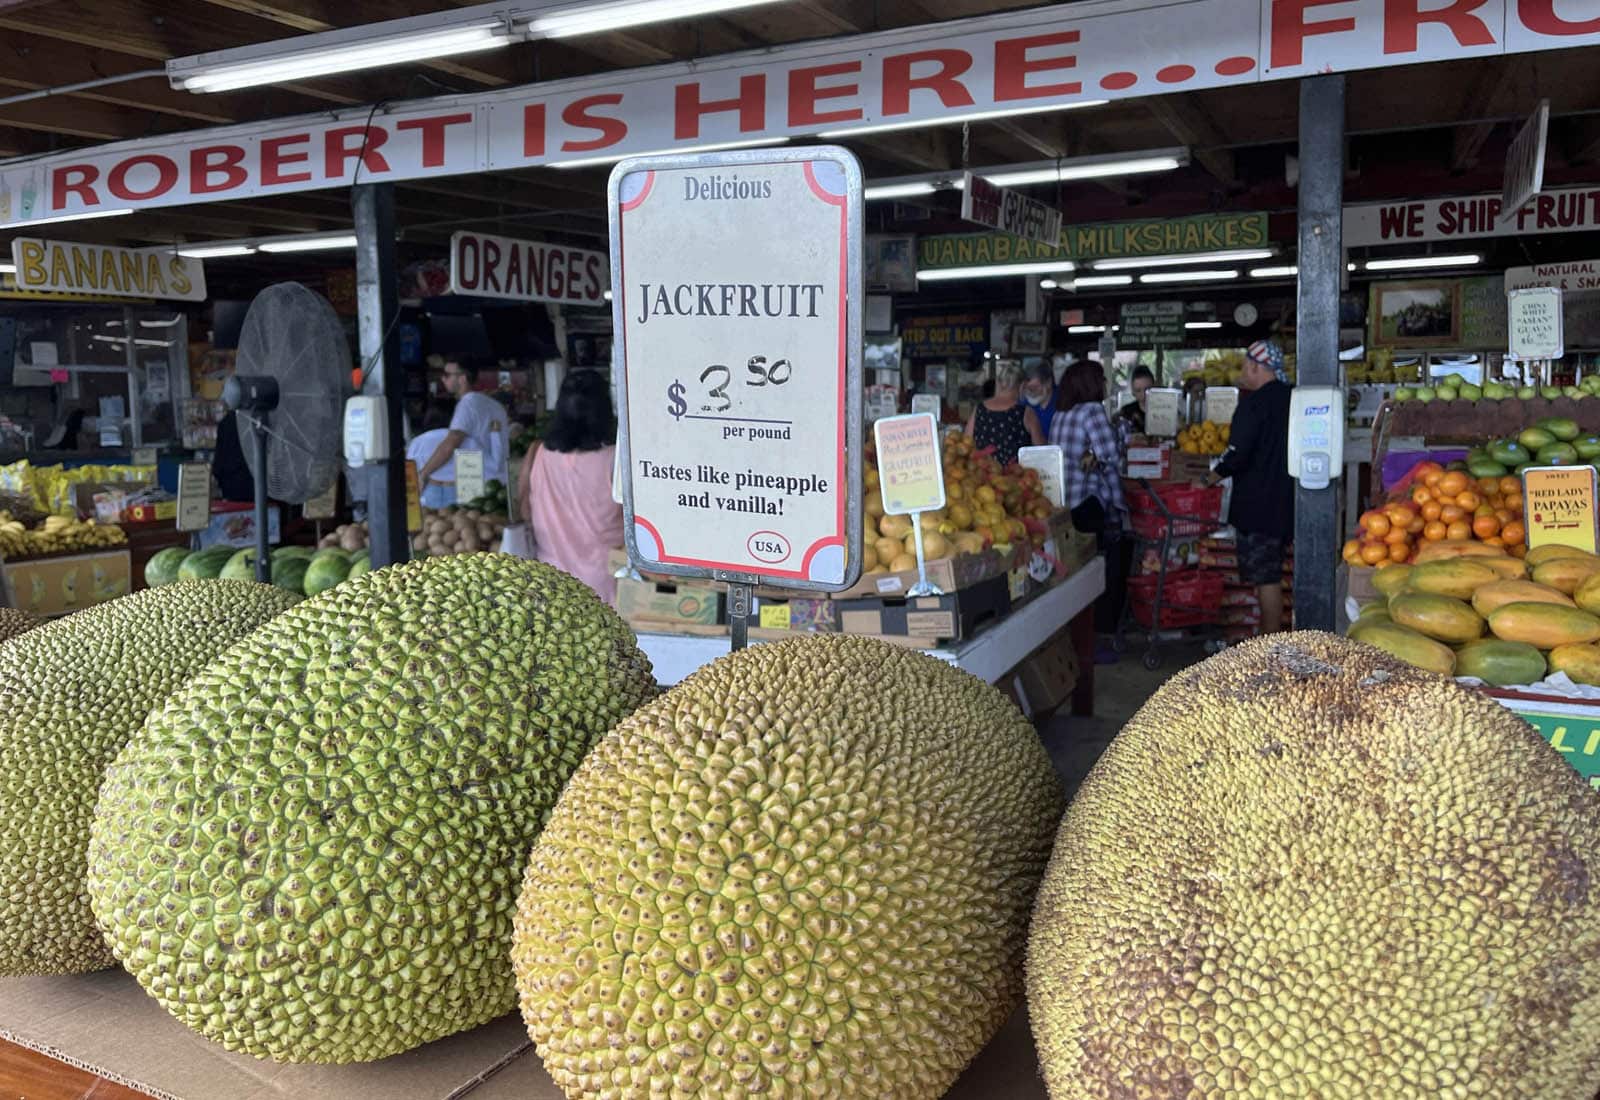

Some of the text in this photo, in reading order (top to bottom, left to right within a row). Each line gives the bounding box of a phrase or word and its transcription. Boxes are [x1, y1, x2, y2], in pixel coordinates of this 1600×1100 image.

[52, 113, 472, 210] ROBERT
[524, 93, 628, 158] IS
[684, 174, 772, 201] Delicious
[1078, 216, 1264, 257] MILKSHAKES
[1380, 204, 1425, 240] WE
[1436, 197, 1503, 235] SHIP
[21, 241, 193, 295] BANANAS
[458, 235, 601, 300] ORANGES
[1537, 262, 1595, 277] NATURAL
[637, 283, 824, 324] JACKFRUIT
[723, 425, 791, 441] per pound
[639, 460, 828, 496] Tastes like pineapple
[678, 492, 784, 517] and vanilla!
[1534, 500, 1588, 511] PAPAYAS
[755, 541, 784, 555] USA
